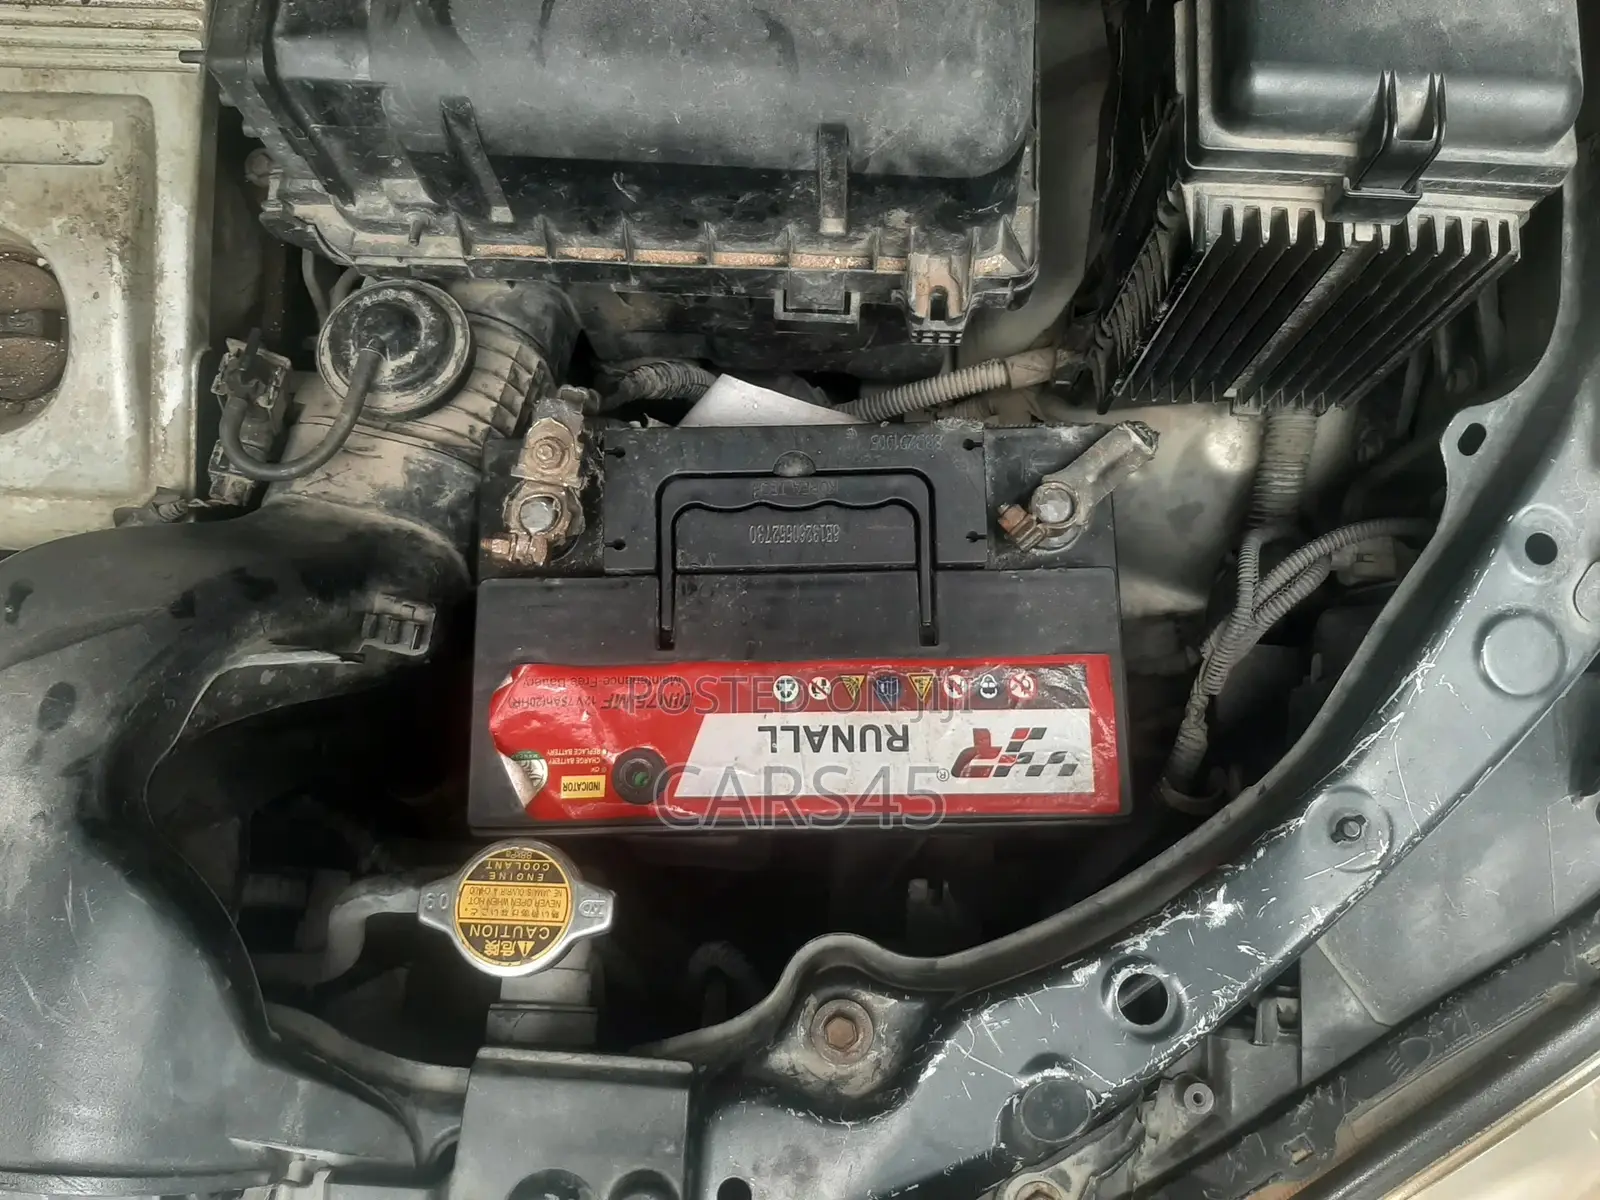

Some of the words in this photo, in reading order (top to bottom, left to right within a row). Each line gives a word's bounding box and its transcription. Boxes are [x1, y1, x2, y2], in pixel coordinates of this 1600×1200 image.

[577, 695, 597, 708] 12V
[757, 724, 909, 754] RUNALL
[546, 748, 573, 756] BATTERY
[573, 748, 601, 756] REPLACE
[547, 757, 575, 765] BATTERY
[575, 756, 601, 764] CHARGE
[563, 781, 601, 792] INDICATOR
[486, 861, 550, 872] COOLANT
[489, 872, 544, 881] ENGINE
[500, 888, 525, 896] OUVRIR
[528, 889, 552, 897] JAMAIS
[554, 889, 563, 897] NE
[487, 897, 509, 906] WHEN
[511, 898, 533, 907] OPEN
[535, 899, 561, 908] NEVER
[469, 924, 550, 939] CAUTION
[483, 940, 518, 957] 危険
